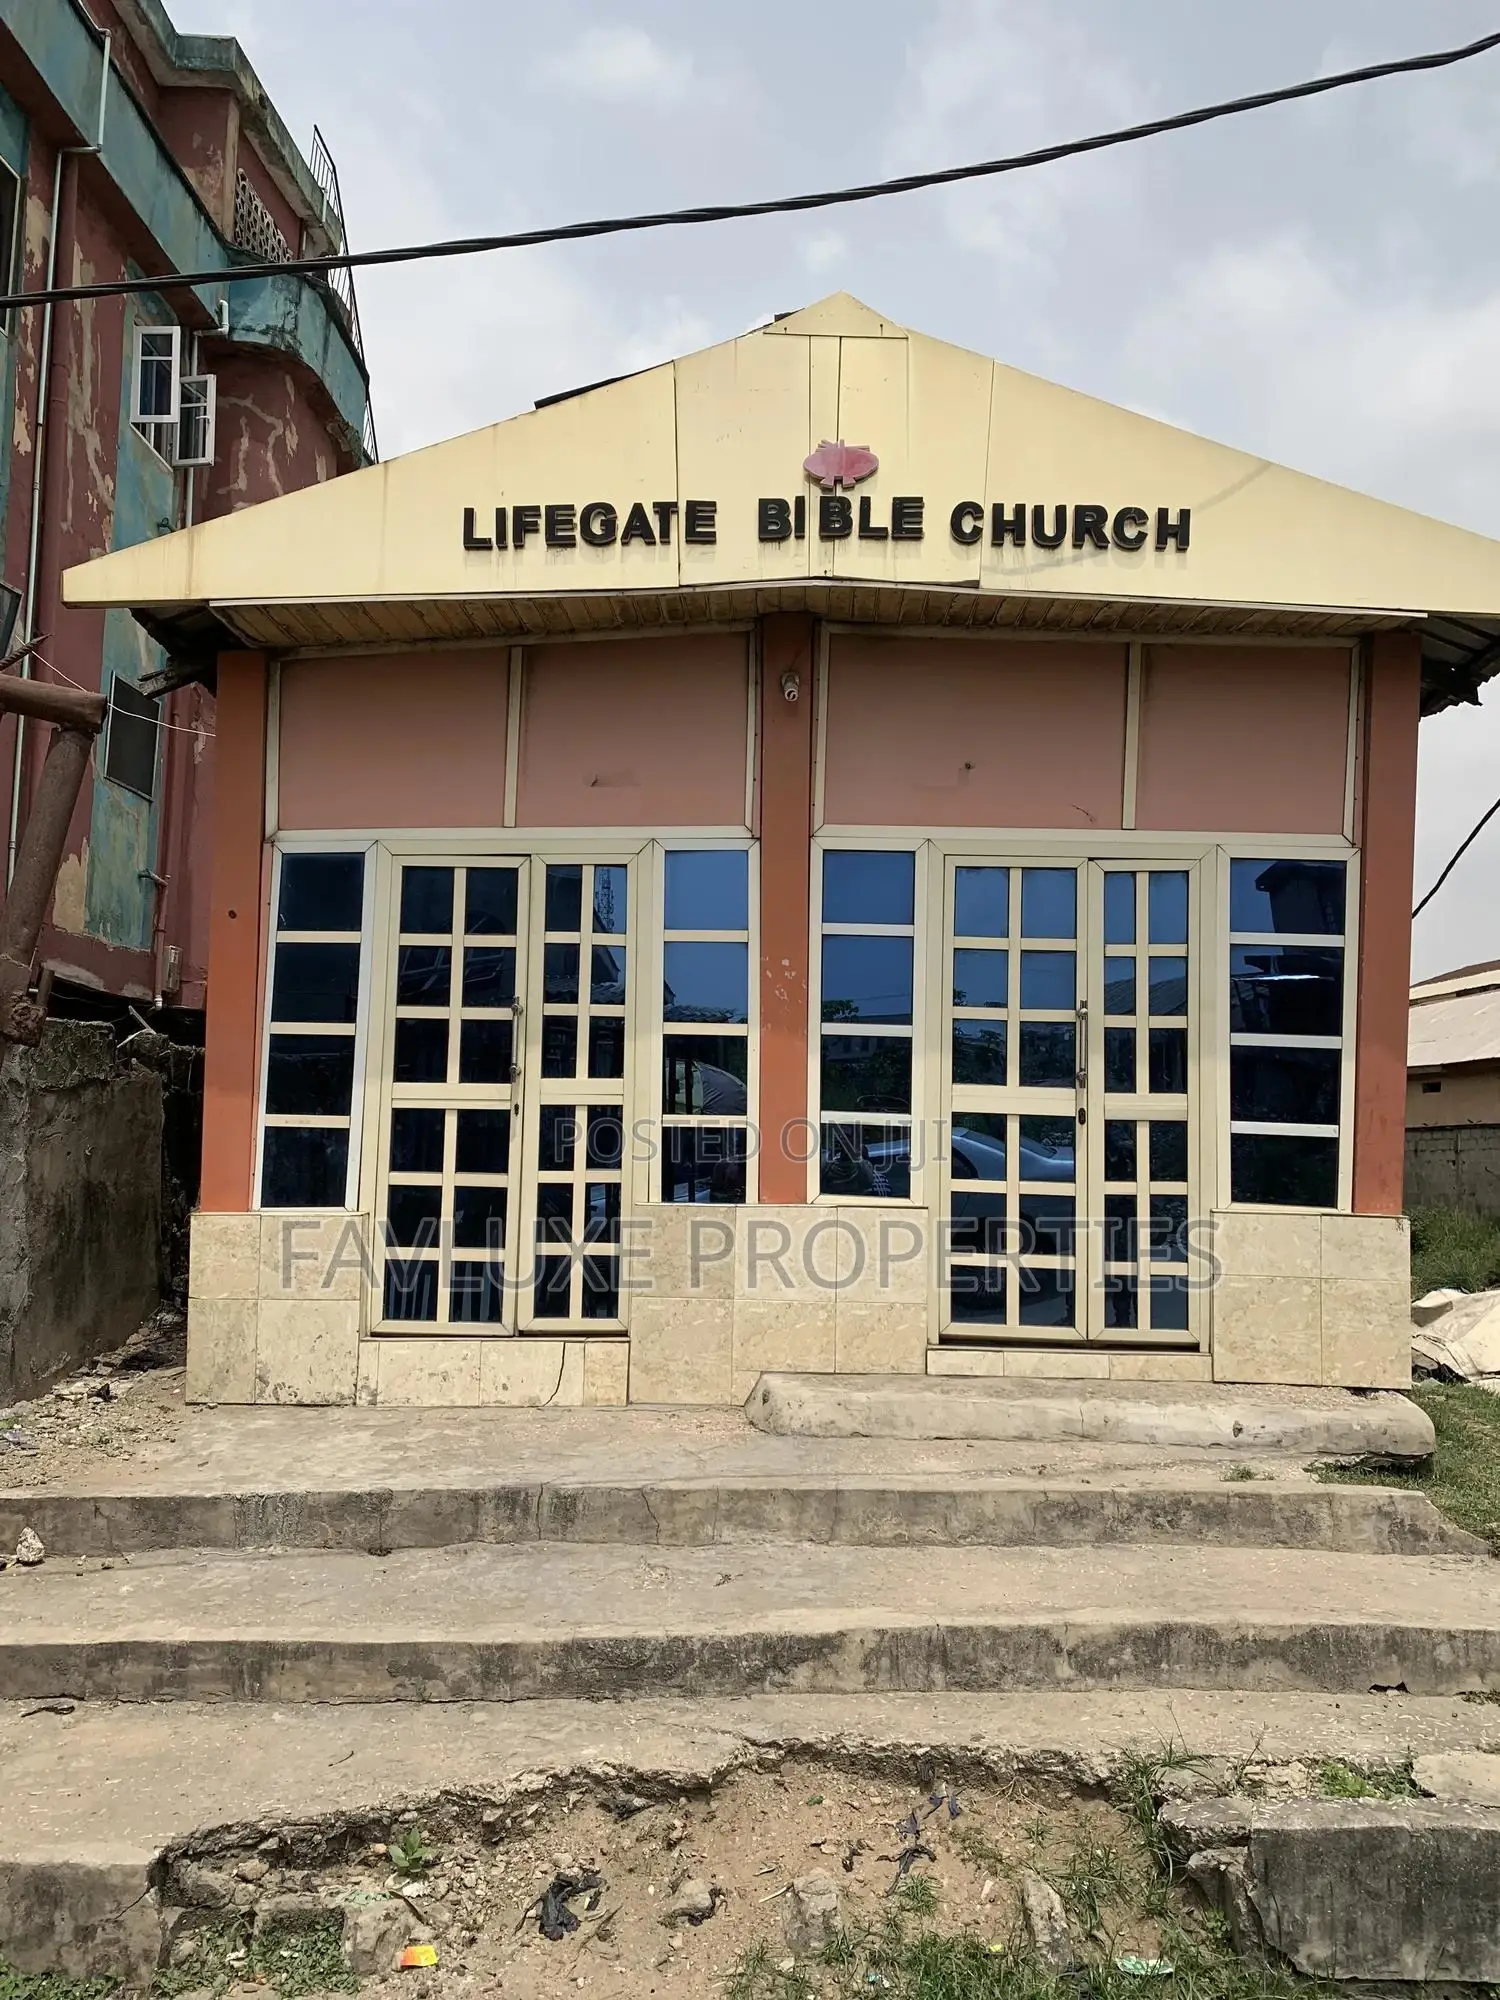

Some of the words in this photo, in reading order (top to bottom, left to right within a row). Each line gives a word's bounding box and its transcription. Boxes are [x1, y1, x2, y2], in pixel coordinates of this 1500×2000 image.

[462, 499, 718, 550] LIFEGATE
[758, 496, 924, 543] BIBLE
[949, 500, 1192, 551] CHURCH
